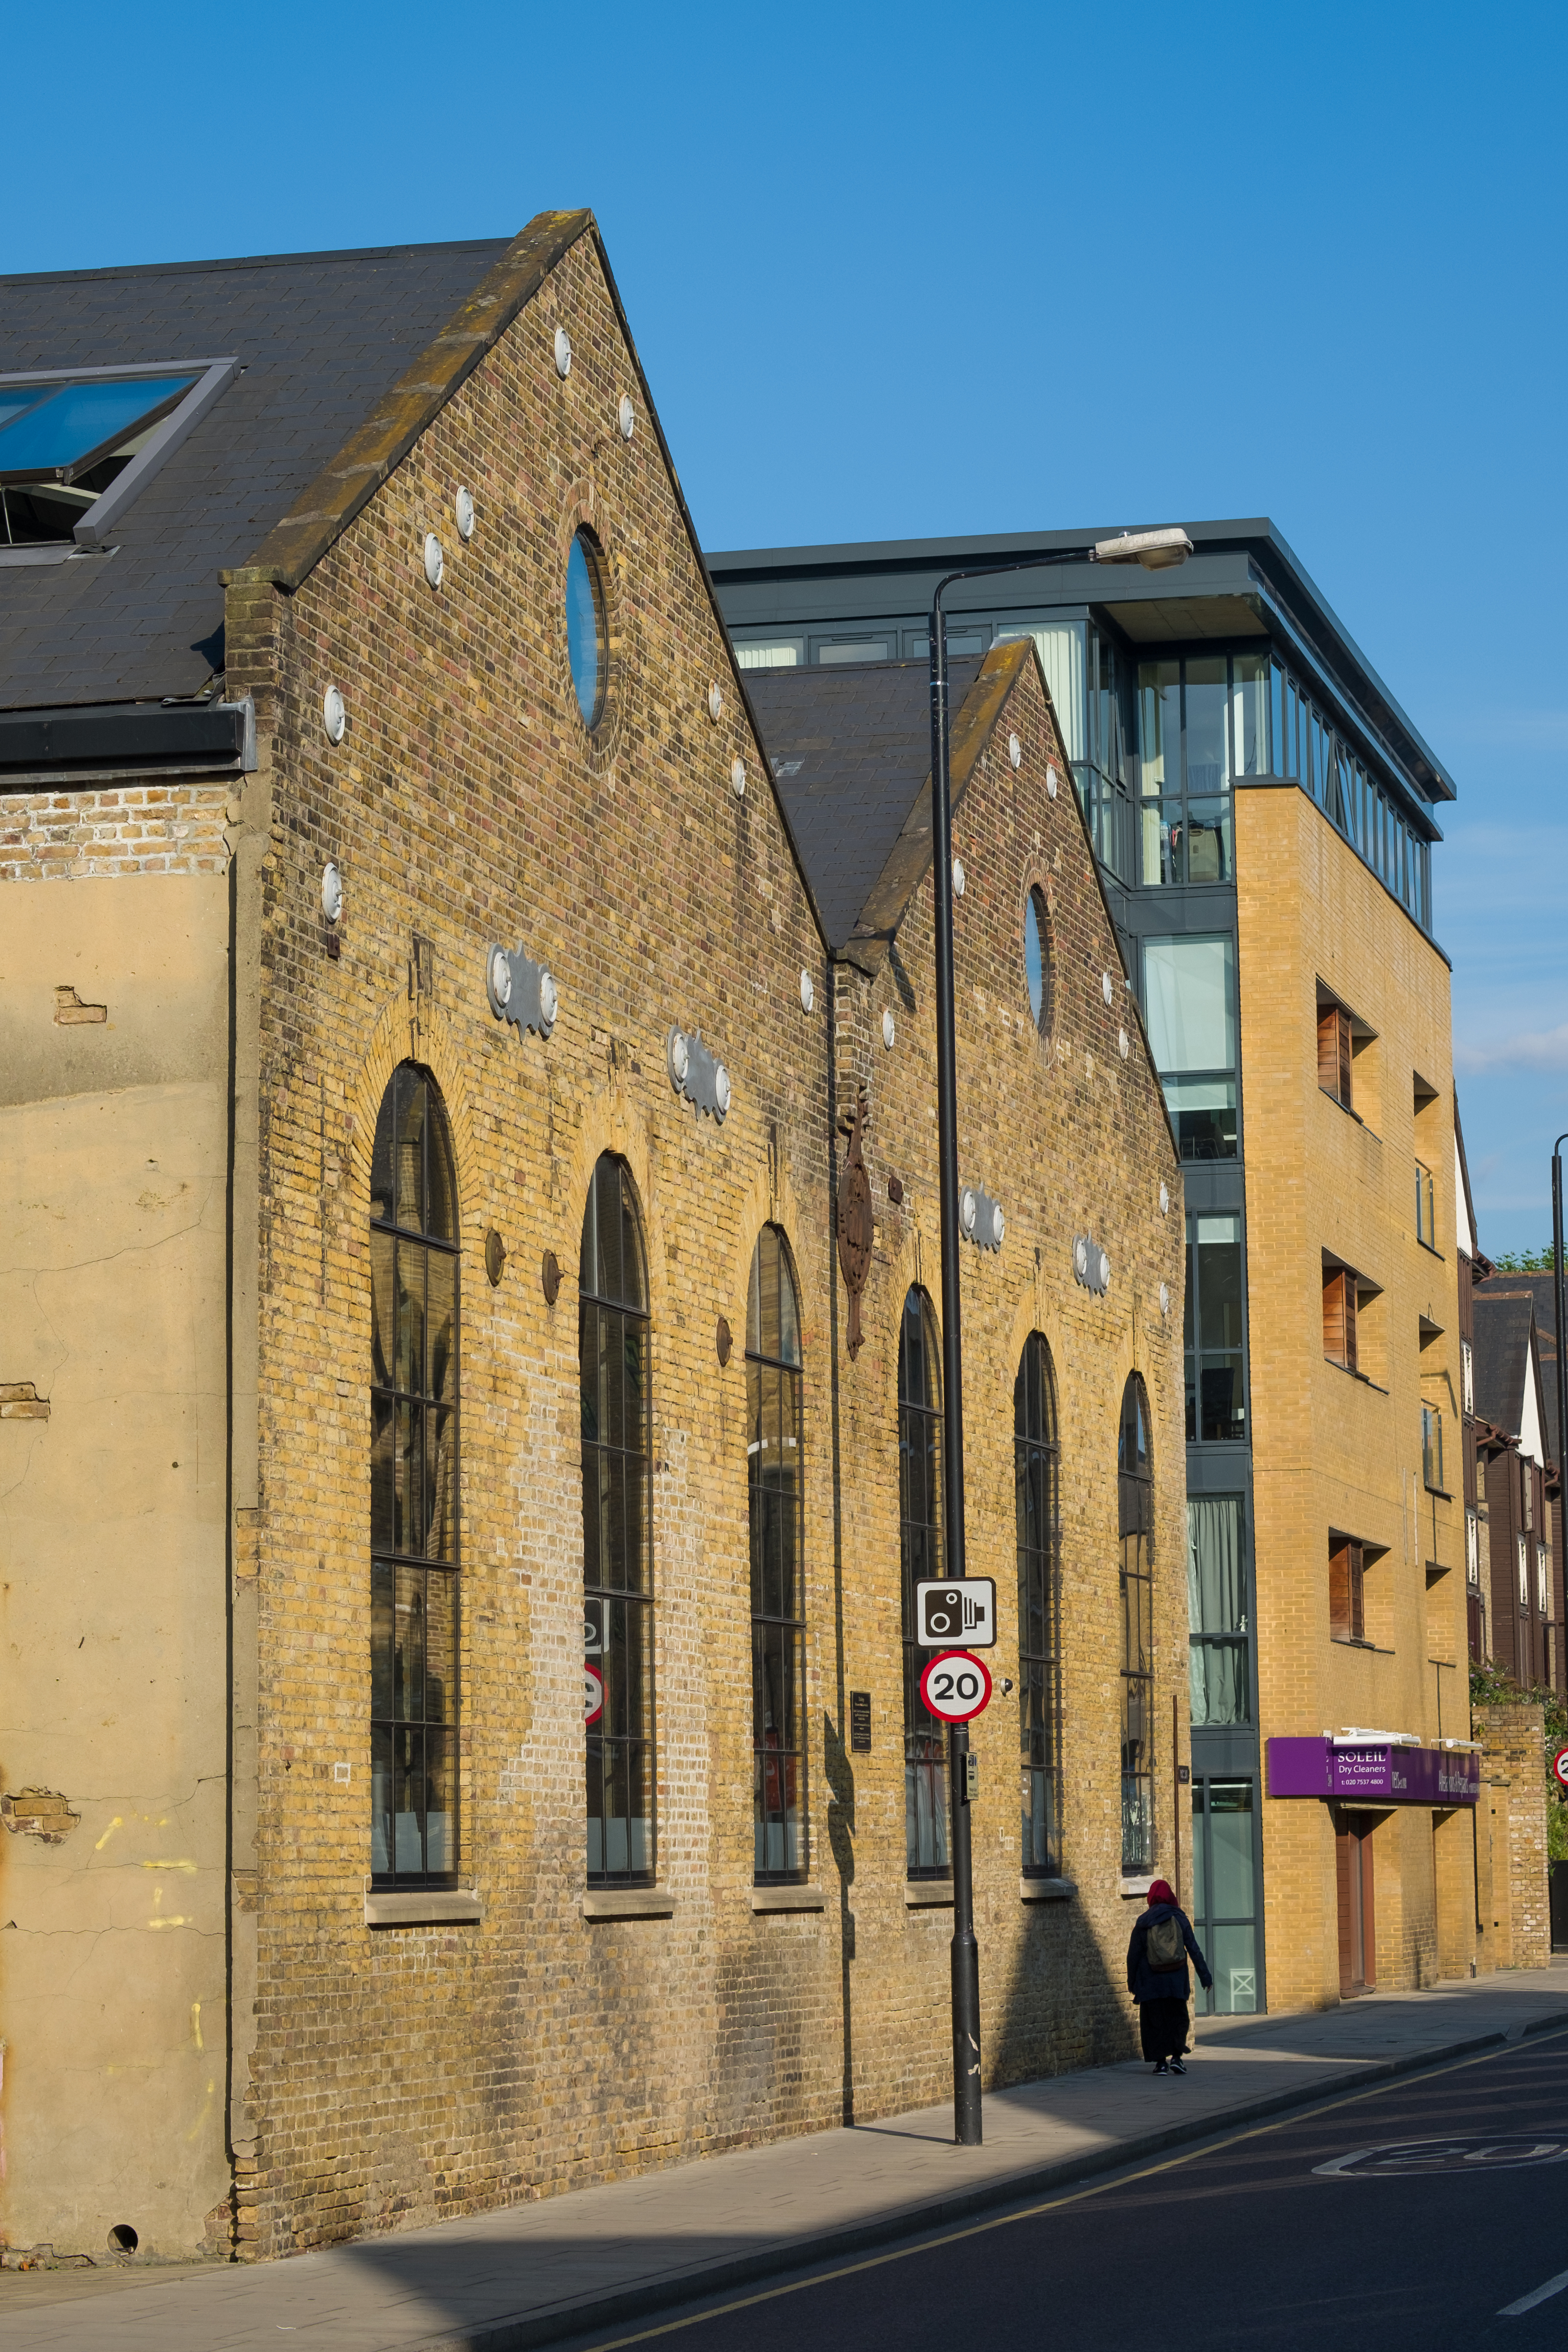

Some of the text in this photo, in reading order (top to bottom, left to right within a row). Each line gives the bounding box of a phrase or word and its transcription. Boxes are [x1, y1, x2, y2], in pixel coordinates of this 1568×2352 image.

[934, 1673, 978, 1700] 20
[1338, 1752, 1386, 1762] SOLEIL
[1339, 1765, 1352, 1775] Dry
[1365, 2144, 1560, 2165] 20
